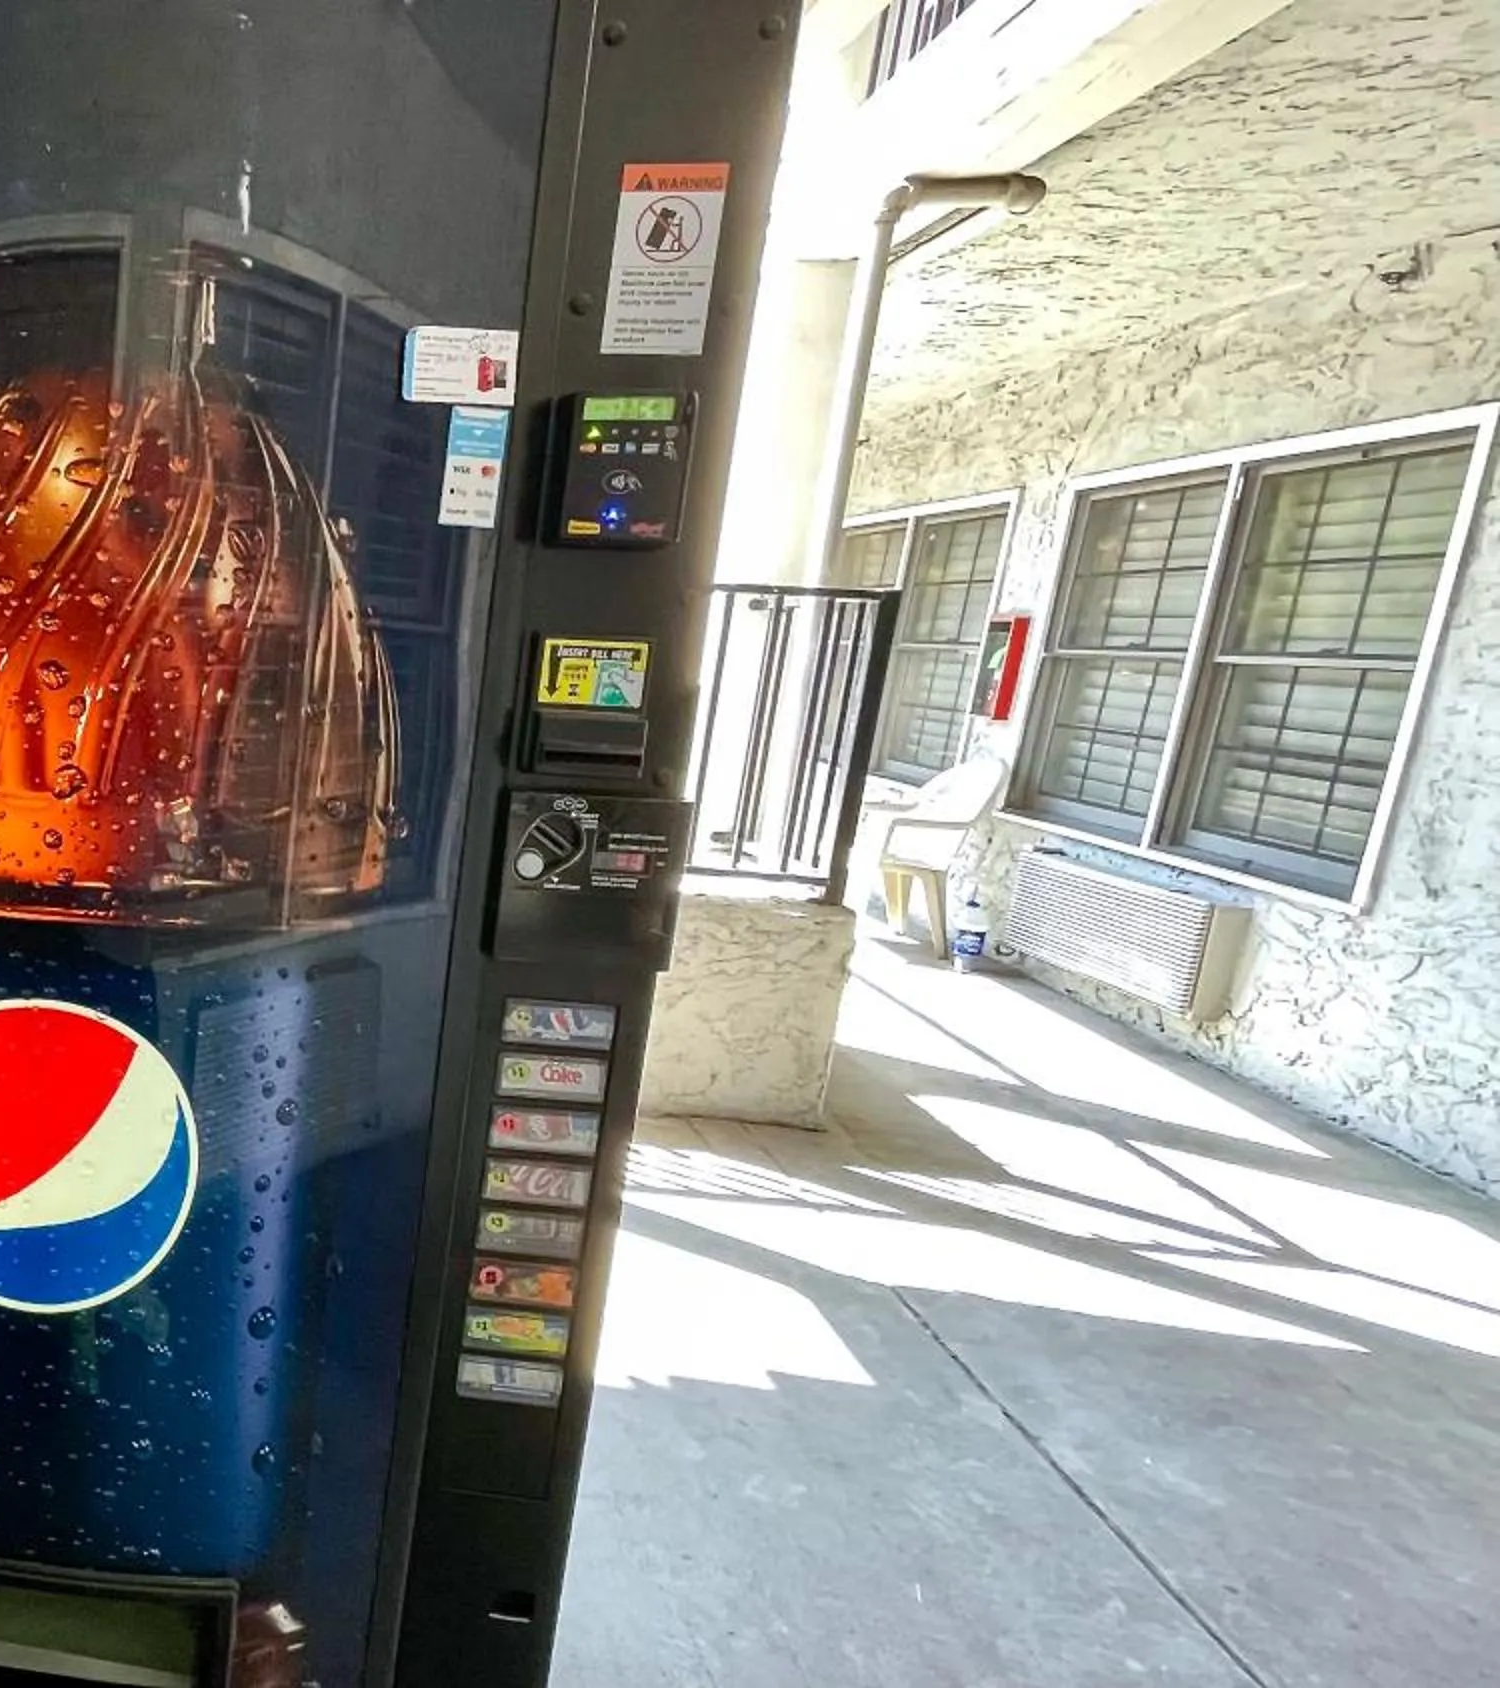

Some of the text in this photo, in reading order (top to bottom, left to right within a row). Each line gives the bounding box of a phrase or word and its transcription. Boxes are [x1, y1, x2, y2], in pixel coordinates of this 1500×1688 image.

[657, 175, 724, 190] WARNING
[557, 647, 634, 659] INSERT BILL HERE
[540, 1063, 583, 1085] Coke
